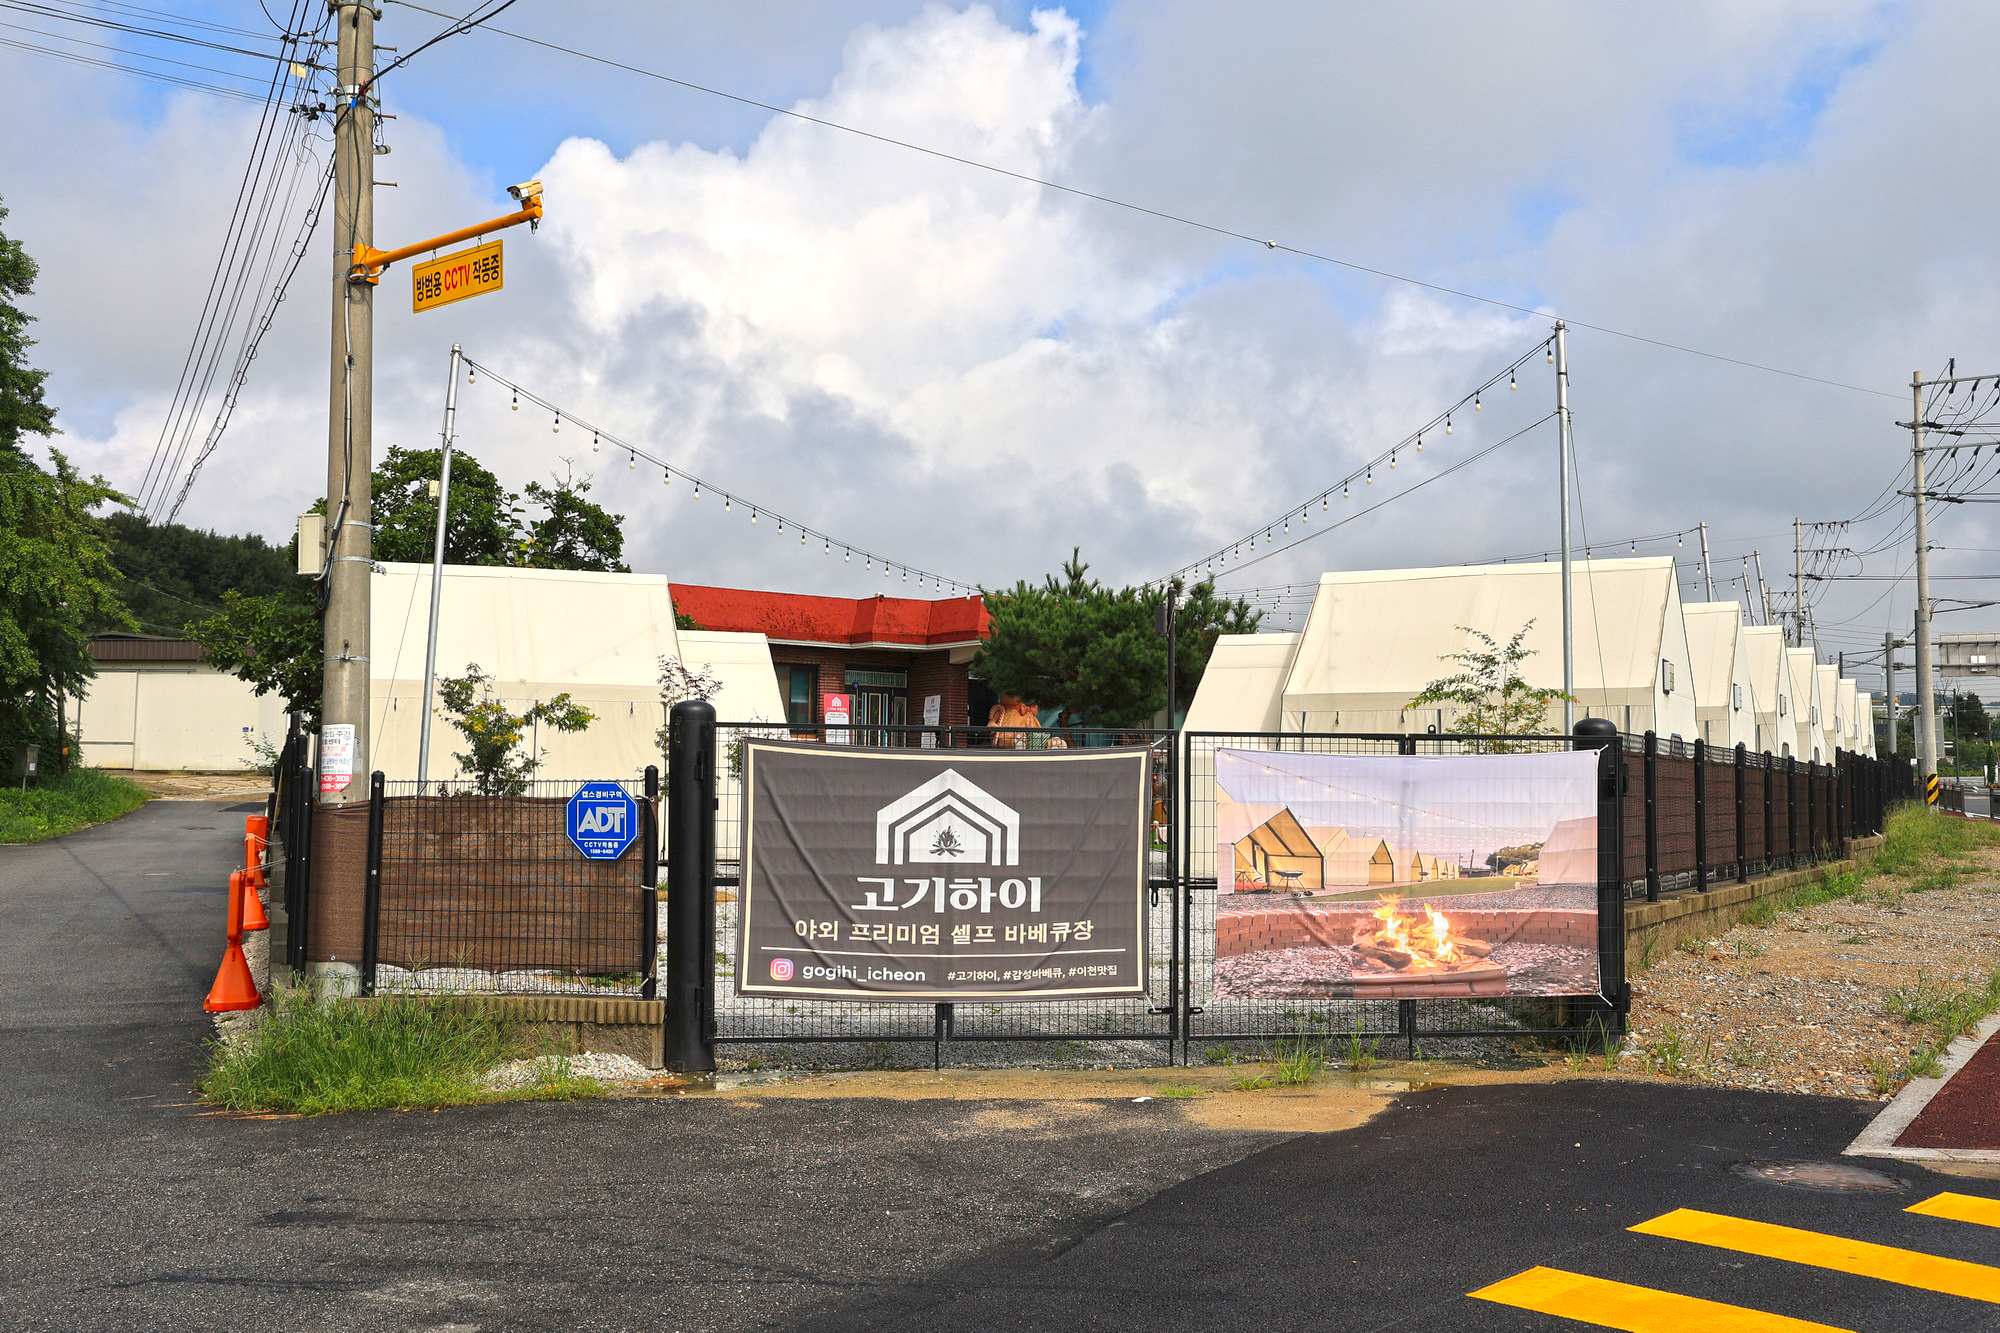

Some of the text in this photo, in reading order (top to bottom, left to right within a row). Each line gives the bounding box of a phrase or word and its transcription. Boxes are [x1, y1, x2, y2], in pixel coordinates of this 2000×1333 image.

[416, 253, 500, 302] 방범용 CCTV 작동중
[578, 806, 625, 833] ADT
[851, 876, 1041, 914] 고기하이
[794, 918, 1094, 946] 야외 프리미엄 셀프 바베큐장
[802, 965, 926, 983] gogihi_icheon
[947, 964, 1118, 982] #고기하이, #감성바베큐, #이천맛집
